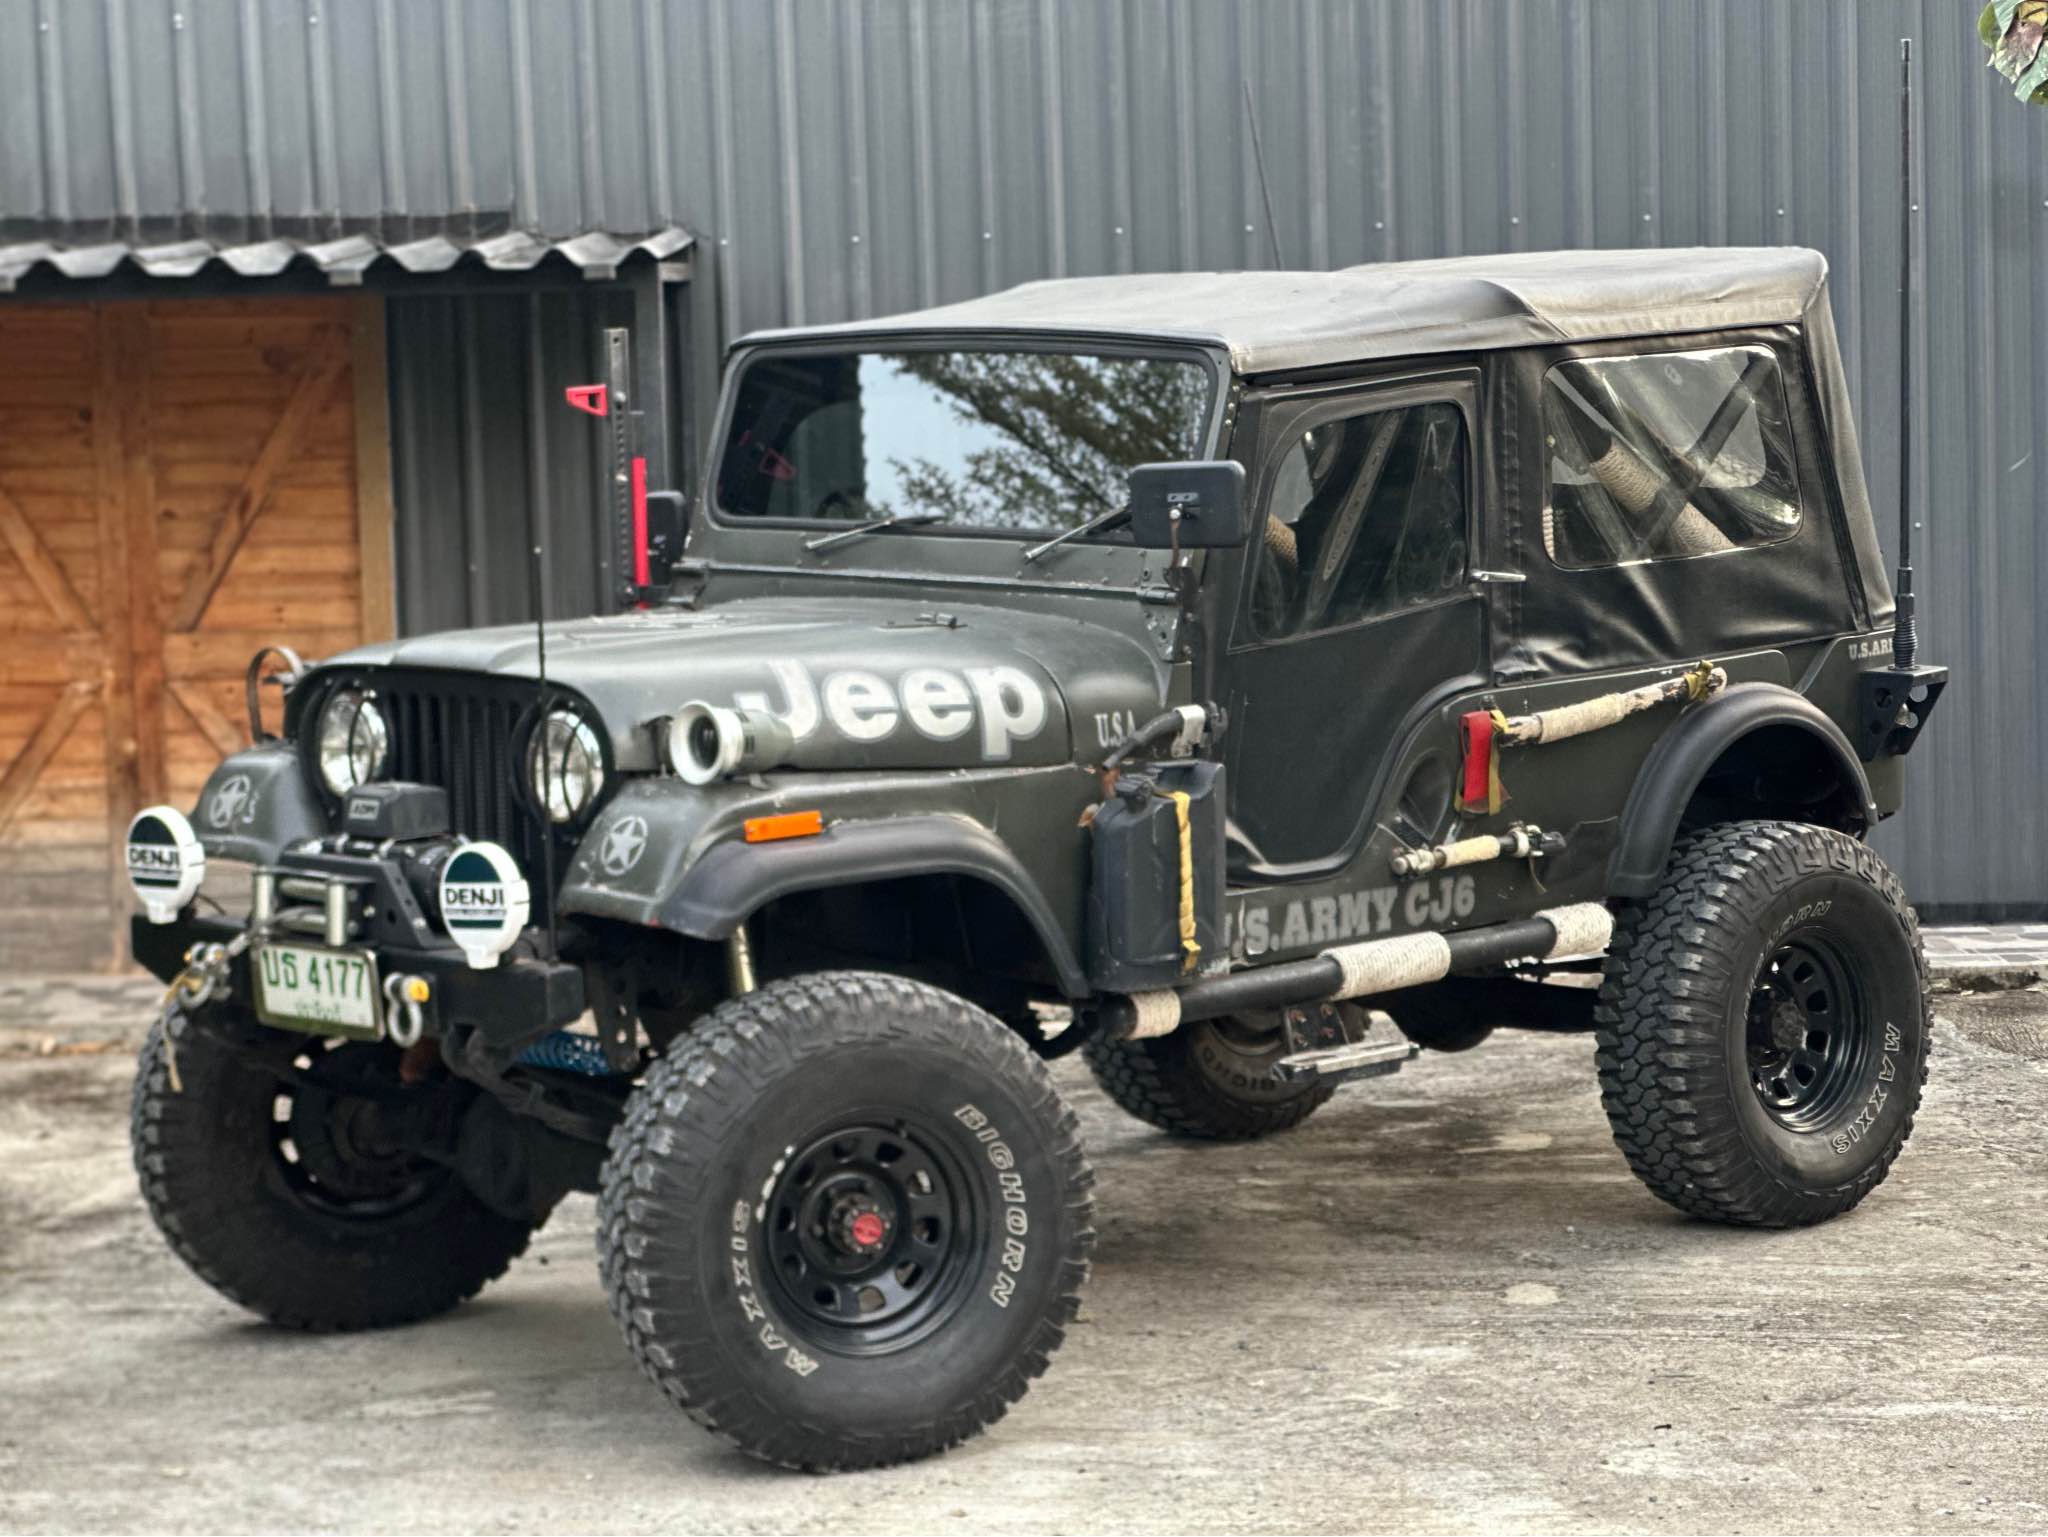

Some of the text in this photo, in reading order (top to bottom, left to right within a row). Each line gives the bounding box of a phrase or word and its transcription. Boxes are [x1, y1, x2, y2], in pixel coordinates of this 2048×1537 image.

[733, 659, 1047, 761] Jeep
[129, 847, 180, 868] DENJI
[445, 887, 504, 907] DENJI
[1224, 874, 1476, 958] .S.ARMY CJ6
[308, 956, 365, 1000] 4177
[1832, 1021, 1902, 1155] MAXXIS
[954, 1103, 1029, 1308] BIGHORN
[731, 1199, 820, 1377] MAXXIS
